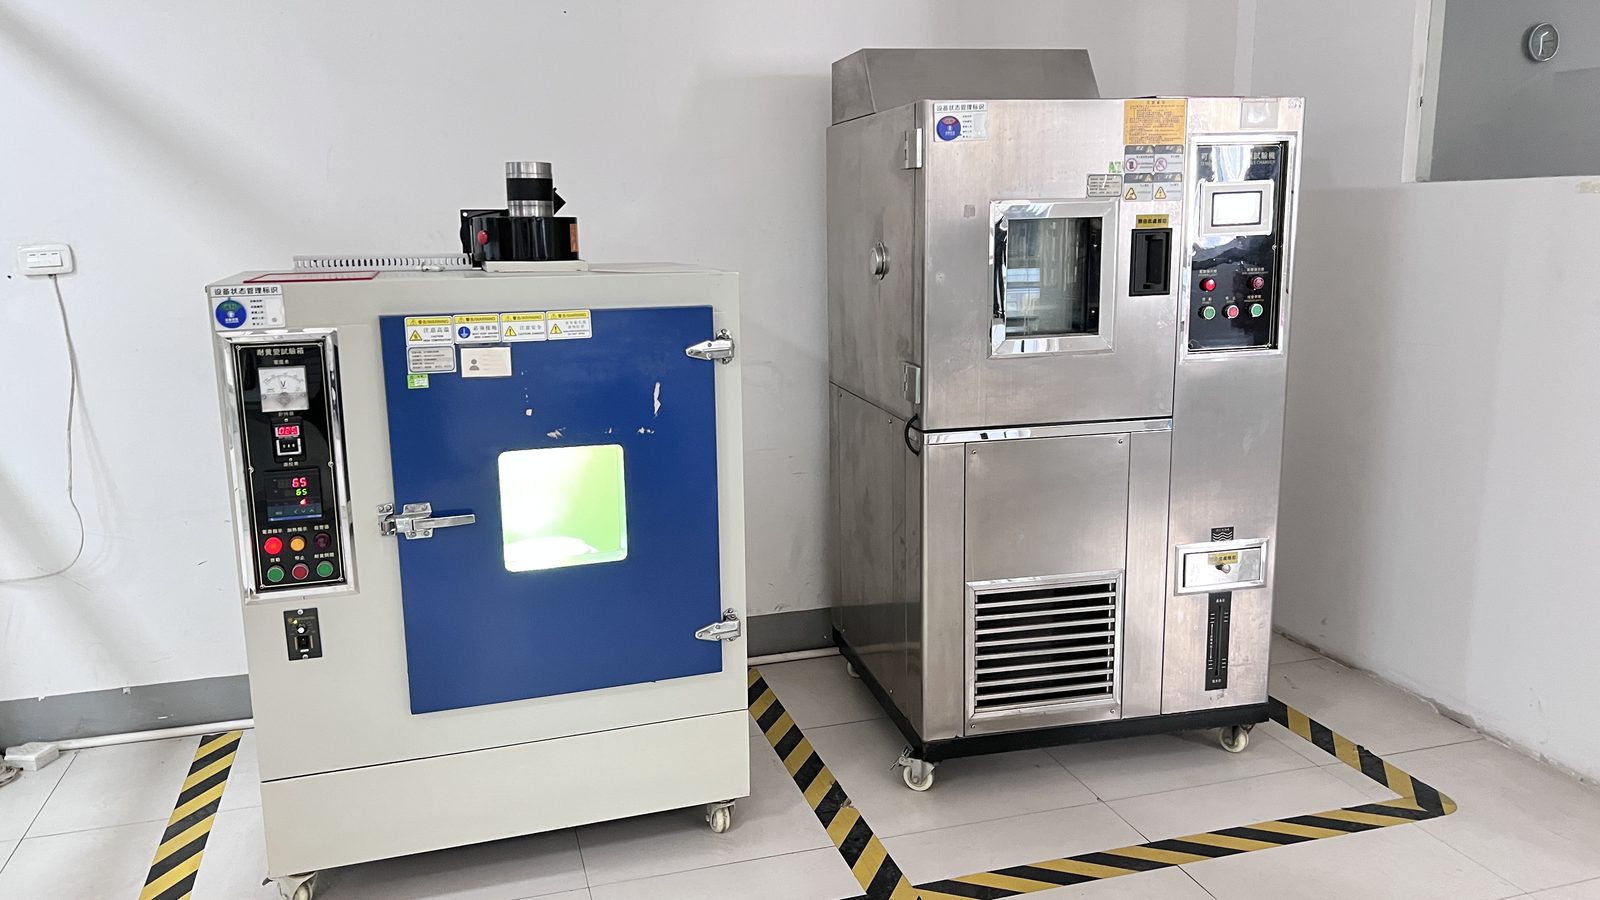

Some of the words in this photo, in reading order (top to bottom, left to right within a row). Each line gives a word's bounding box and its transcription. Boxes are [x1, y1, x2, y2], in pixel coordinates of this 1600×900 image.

[936, 103, 985, 111] 设备状态管理标识
[214, 286, 279, 296] 设备状态管理标识
[292, 477, 307, 488] 65
[295, 488, 308, 496] 65
